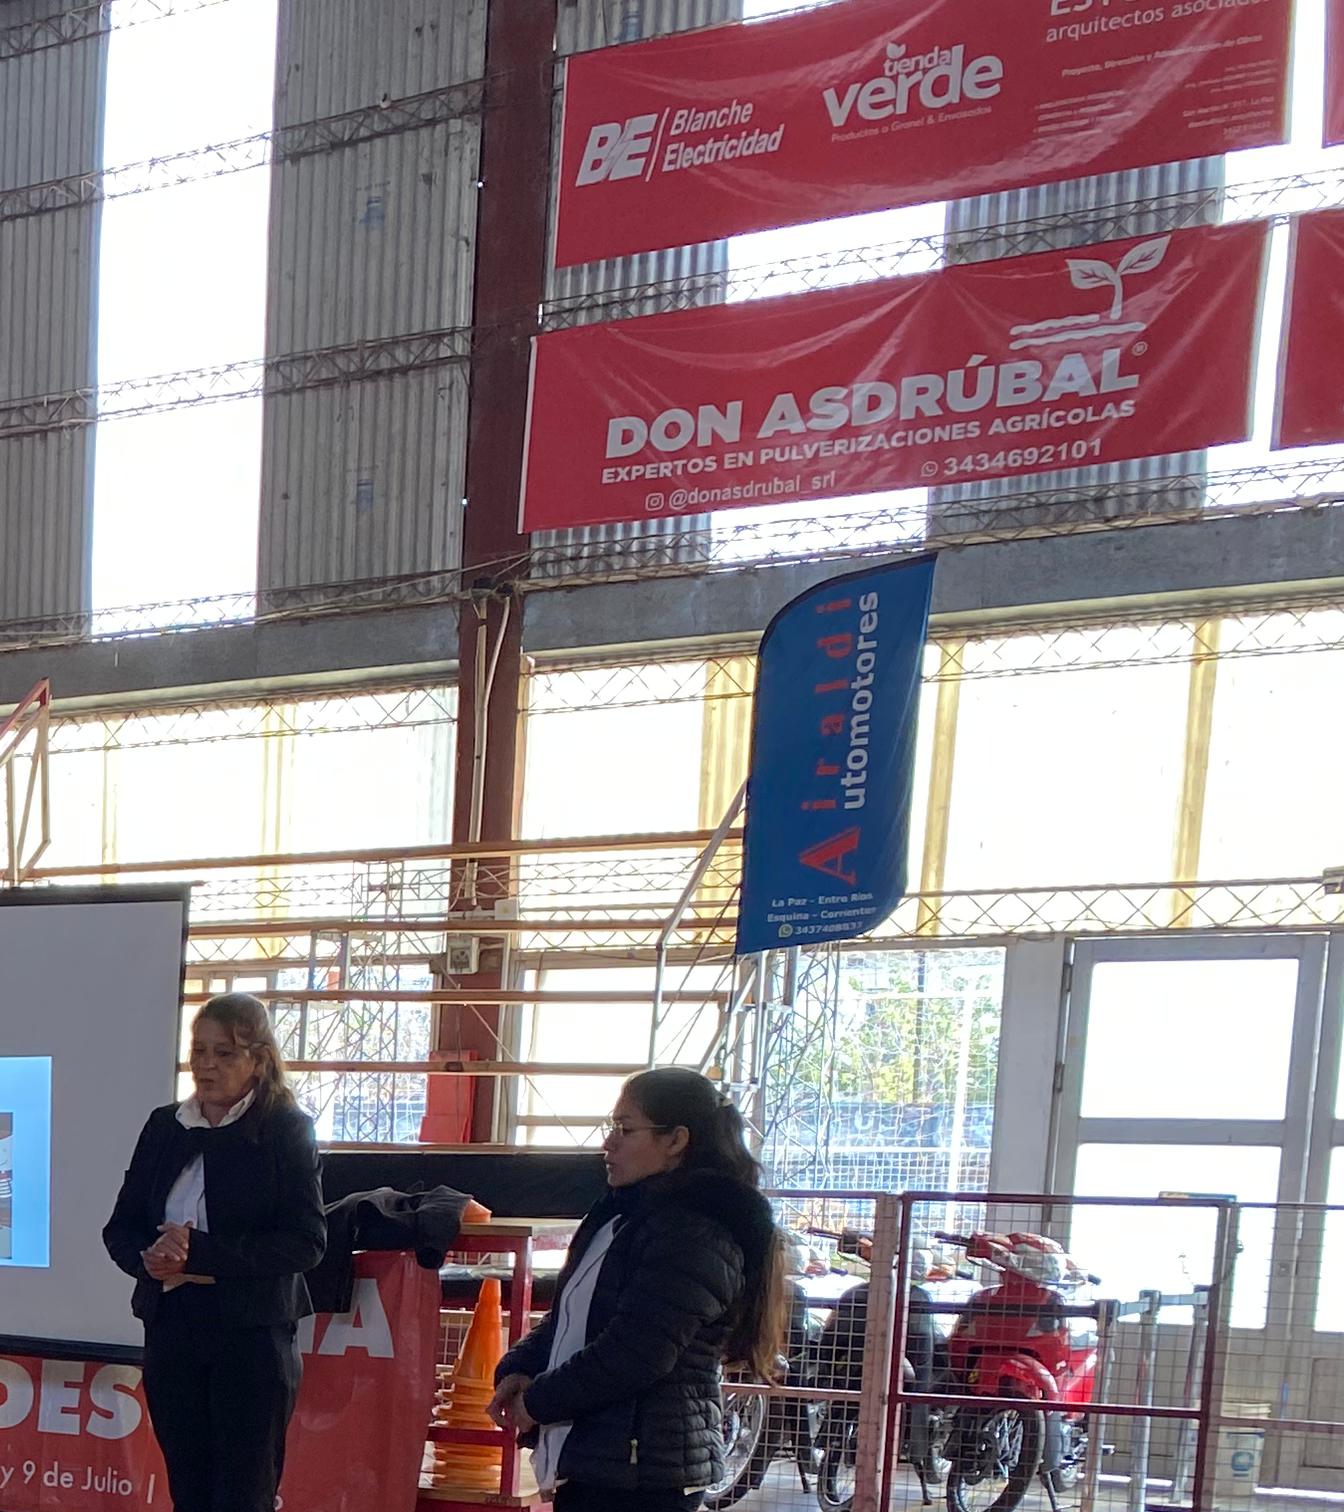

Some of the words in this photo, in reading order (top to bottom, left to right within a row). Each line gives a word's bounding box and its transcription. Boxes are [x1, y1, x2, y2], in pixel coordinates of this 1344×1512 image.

[1046, 7, 1164, 42] arquitectos
[883, 46, 952, 77] tienda
[822, 44, 1004, 128] verde
[670, 100, 753, 136] Blanche
[891, 117, 925, 132] Granel
[927, 114, 935, 125] &
[575, 113, 658, 188] BE
[662, 124, 785, 173] Electricidad
[605, 400, 743, 459] DON
[757, 348, 1140, 439] ASDRÚBAL
[601, 456, 718, 484] EXPERTOS
[723, 450, 754, 470] EN
[760, 420, 981, 467] PULVERIZACIONES
[988, 400, 1137, 436] AGRÍCOLAS
[943, 438, 1103, 477] 3434692101
[669, 470, 837, 511] @donasdrubal_srl
[767, 913, 810, 923] Esquina
[772, 899, 785, 908] La
[788, 897, 807, 907] Paz
[818, 894, 849, 905] Entre
[0, 1464, 16, 1490] y
[23, 1462, 37, 1485] 9
[43, 1462, 74, 1489] de
[81, 1466, 133, 1497] Julio
